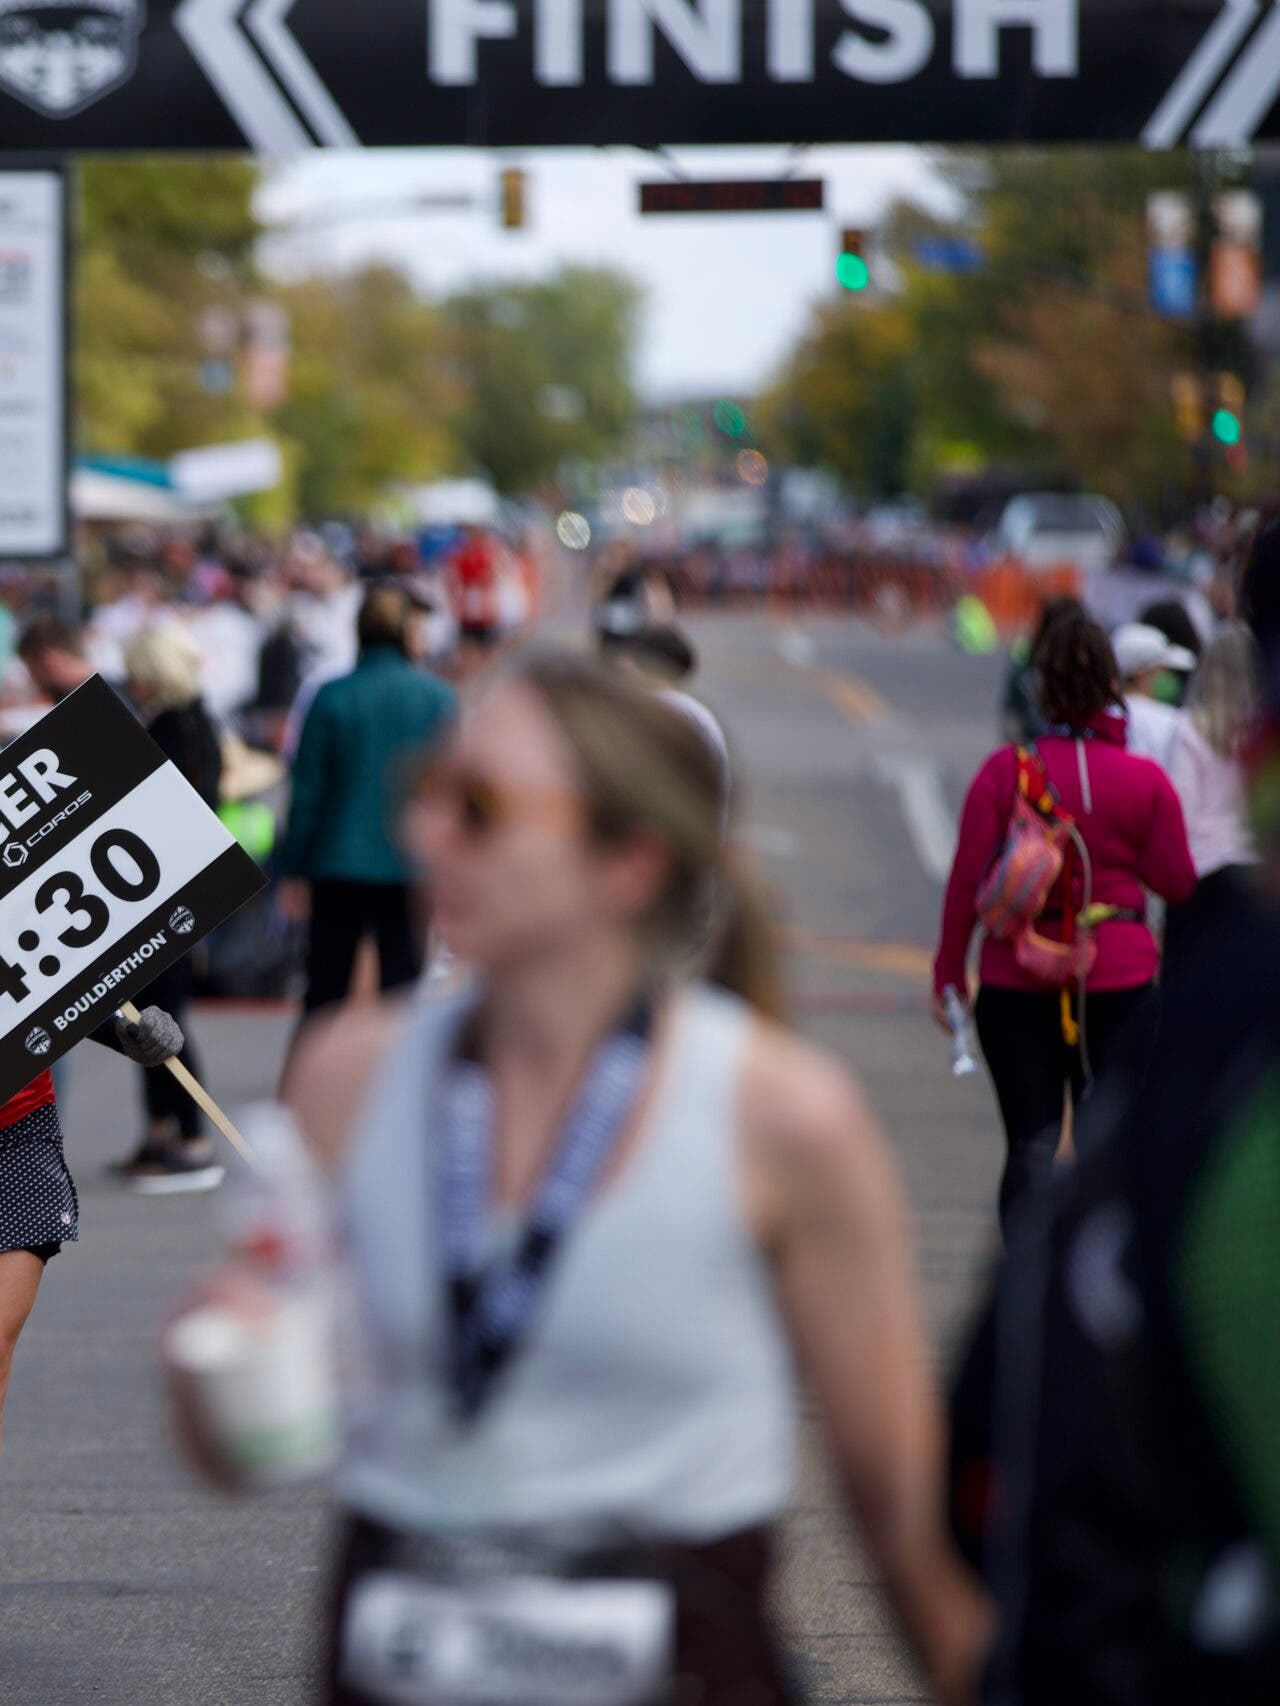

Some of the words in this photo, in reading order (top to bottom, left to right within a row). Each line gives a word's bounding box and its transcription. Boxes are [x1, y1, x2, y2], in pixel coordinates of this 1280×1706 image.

[428, 0, 1080, 86] FINISH
[26, 789, 92, 849] COROS
[53, 932, 167, 1031] BOULDERTHON
